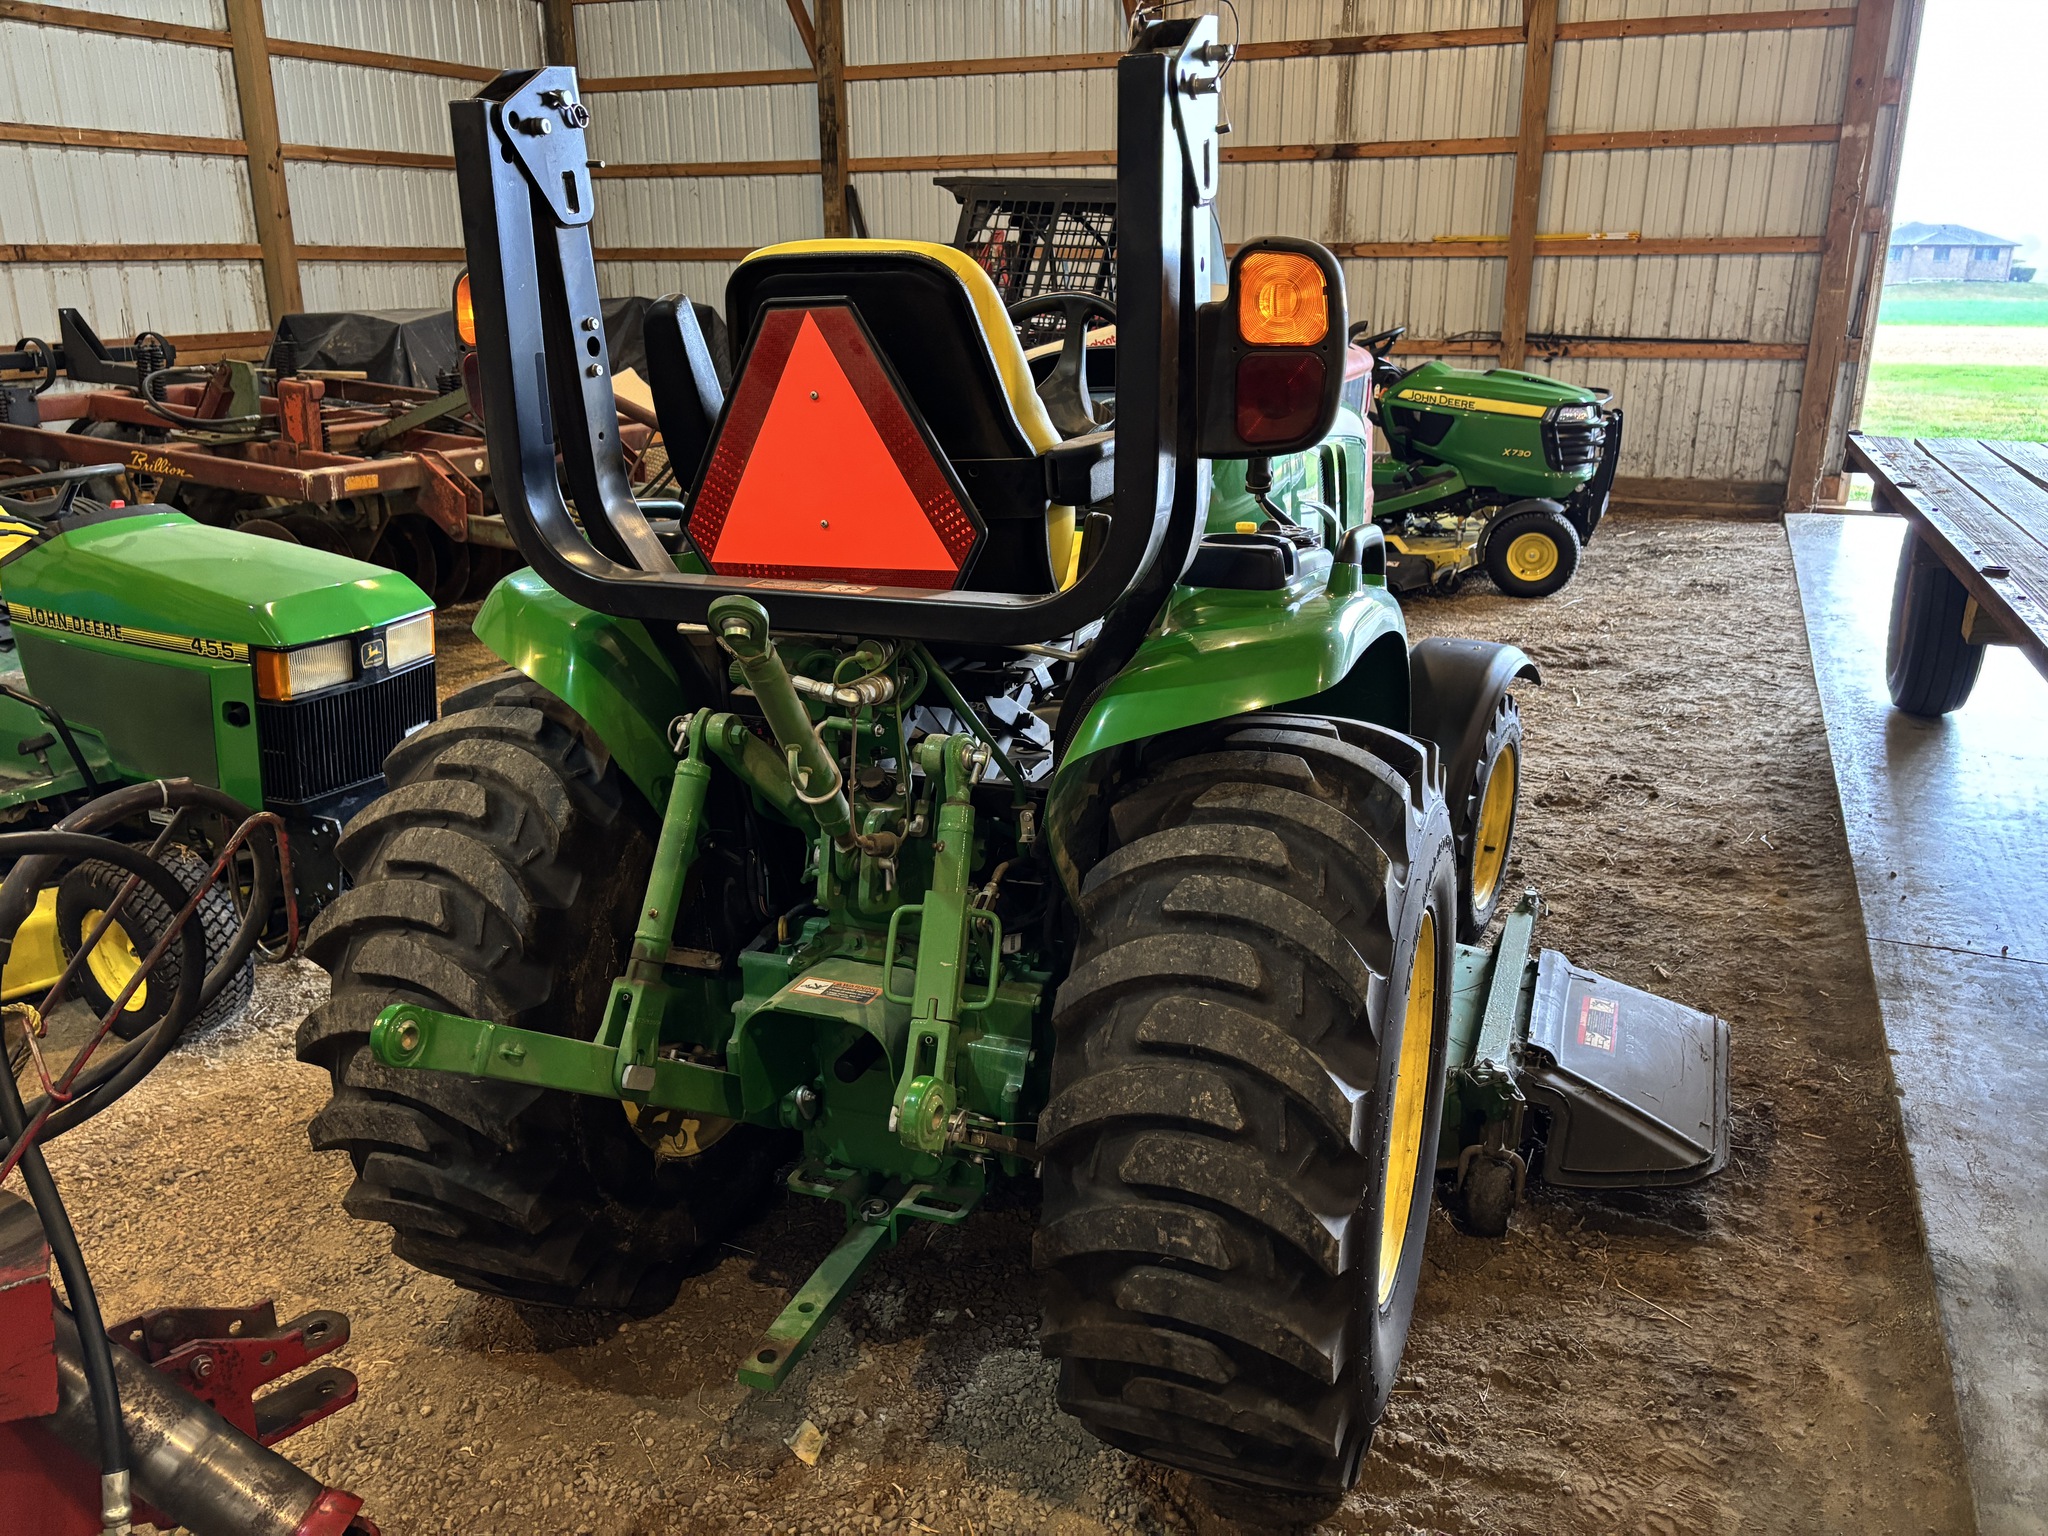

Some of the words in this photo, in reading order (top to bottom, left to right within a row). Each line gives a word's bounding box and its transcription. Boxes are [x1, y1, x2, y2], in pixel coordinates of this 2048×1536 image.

[1408, 391, 1437, 404] JOHN
[1439, 395, 1476, 410] DEERE
[125, 450, 194, 478] Brillion
[1502, 448, 1532, 458] X730
[27, 607, 68, 630] JOHN
[72, 616, 123, 640] DEERE
[191, 637, 235, 659] 455
